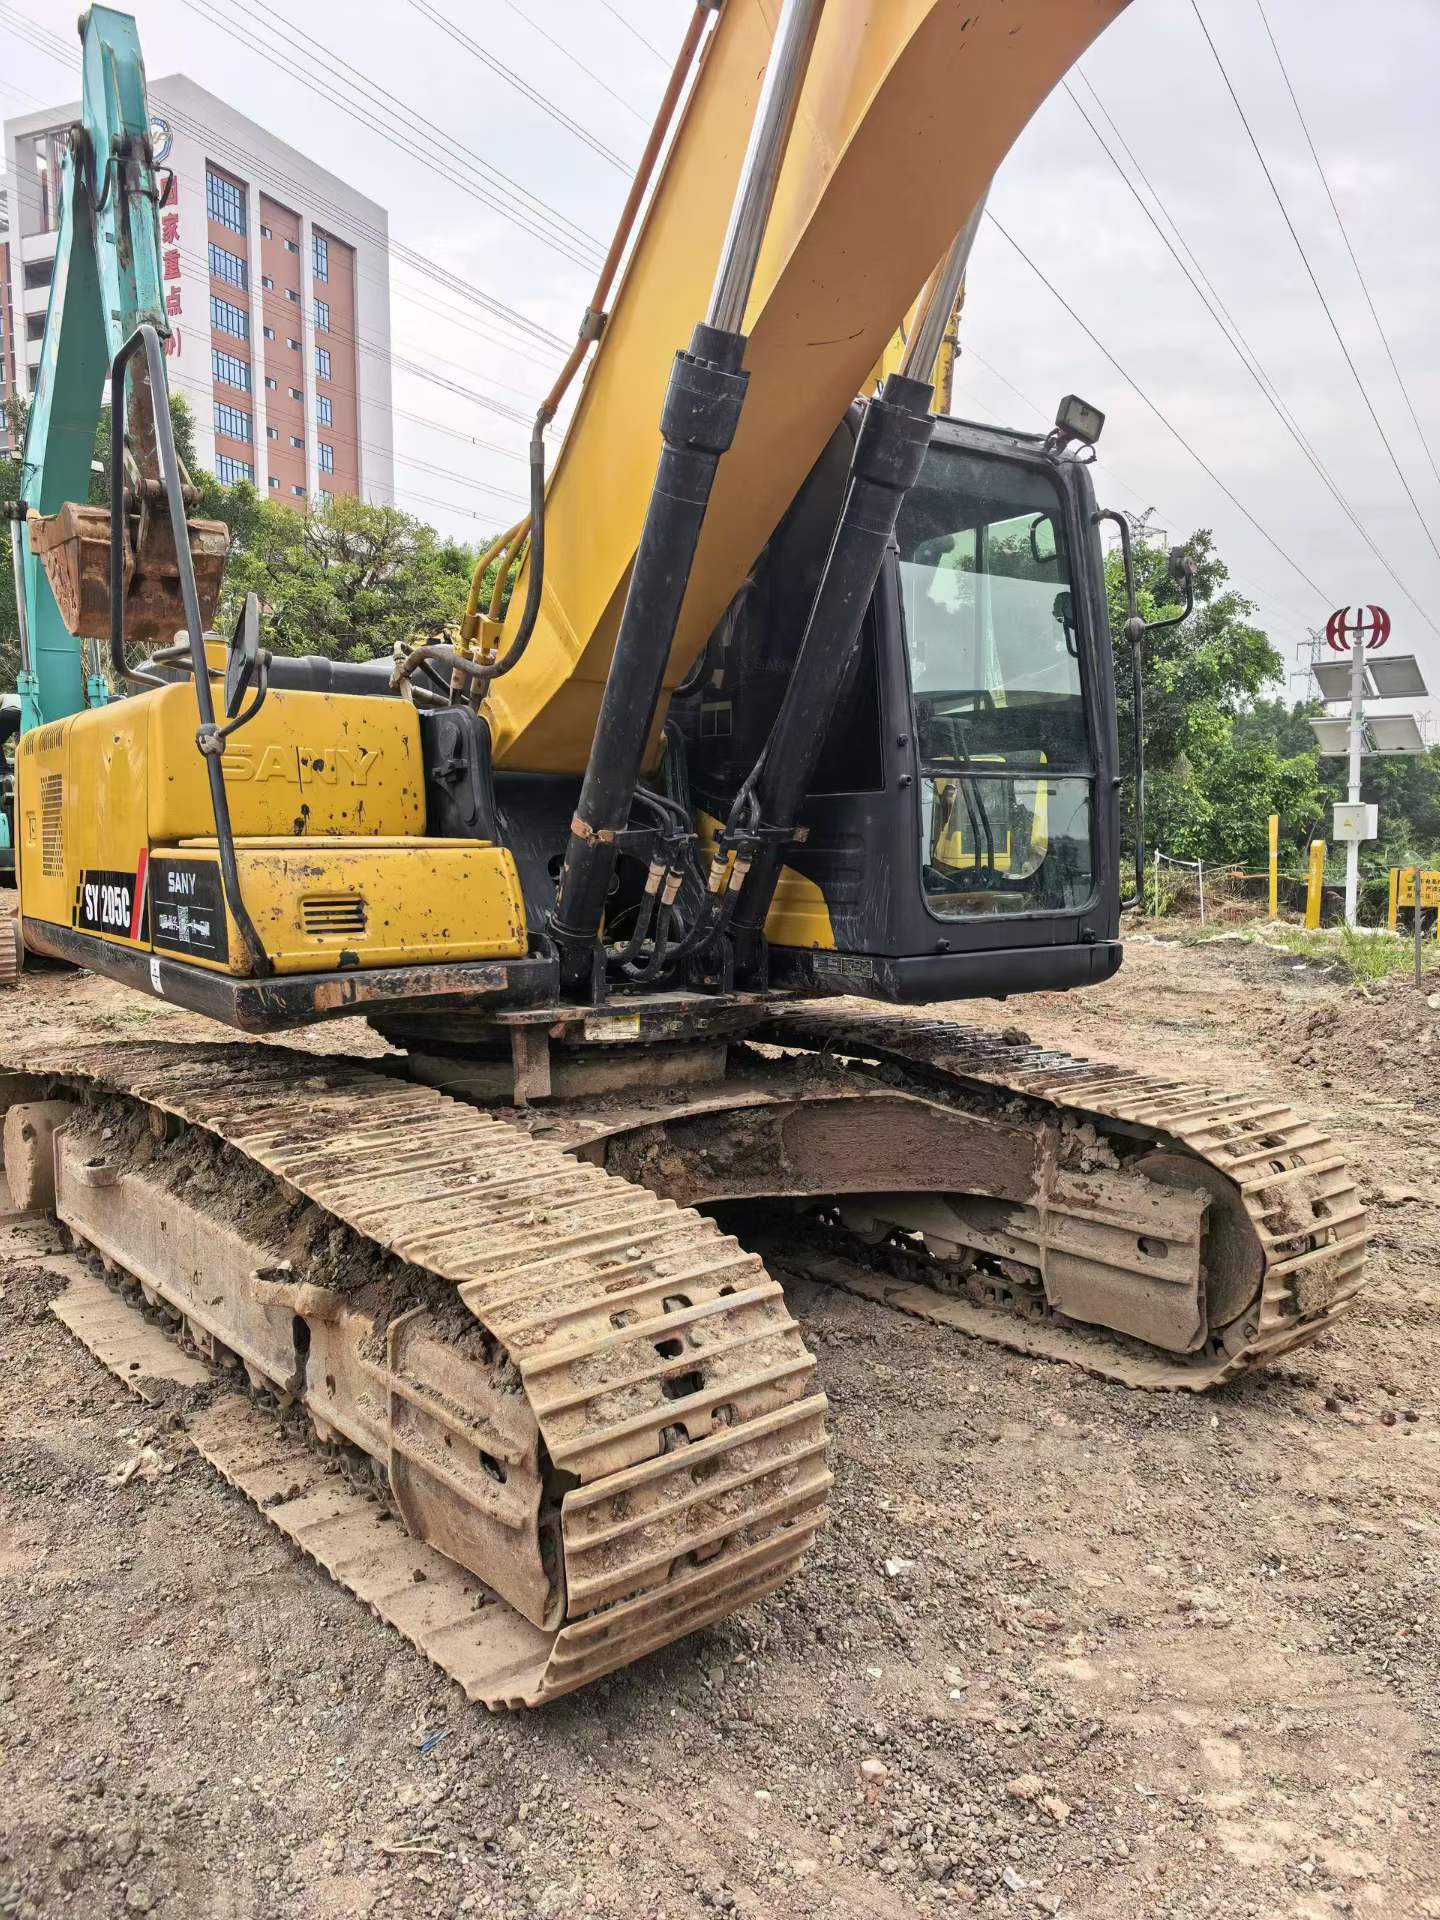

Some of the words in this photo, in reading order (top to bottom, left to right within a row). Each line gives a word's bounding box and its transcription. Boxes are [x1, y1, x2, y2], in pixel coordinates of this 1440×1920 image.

[222, 744, 379, 786] SANY
[168, 871, 196, 895] SANY
[85, 883, 99, 922] SY
[101, 885, 131, 928] 205C
